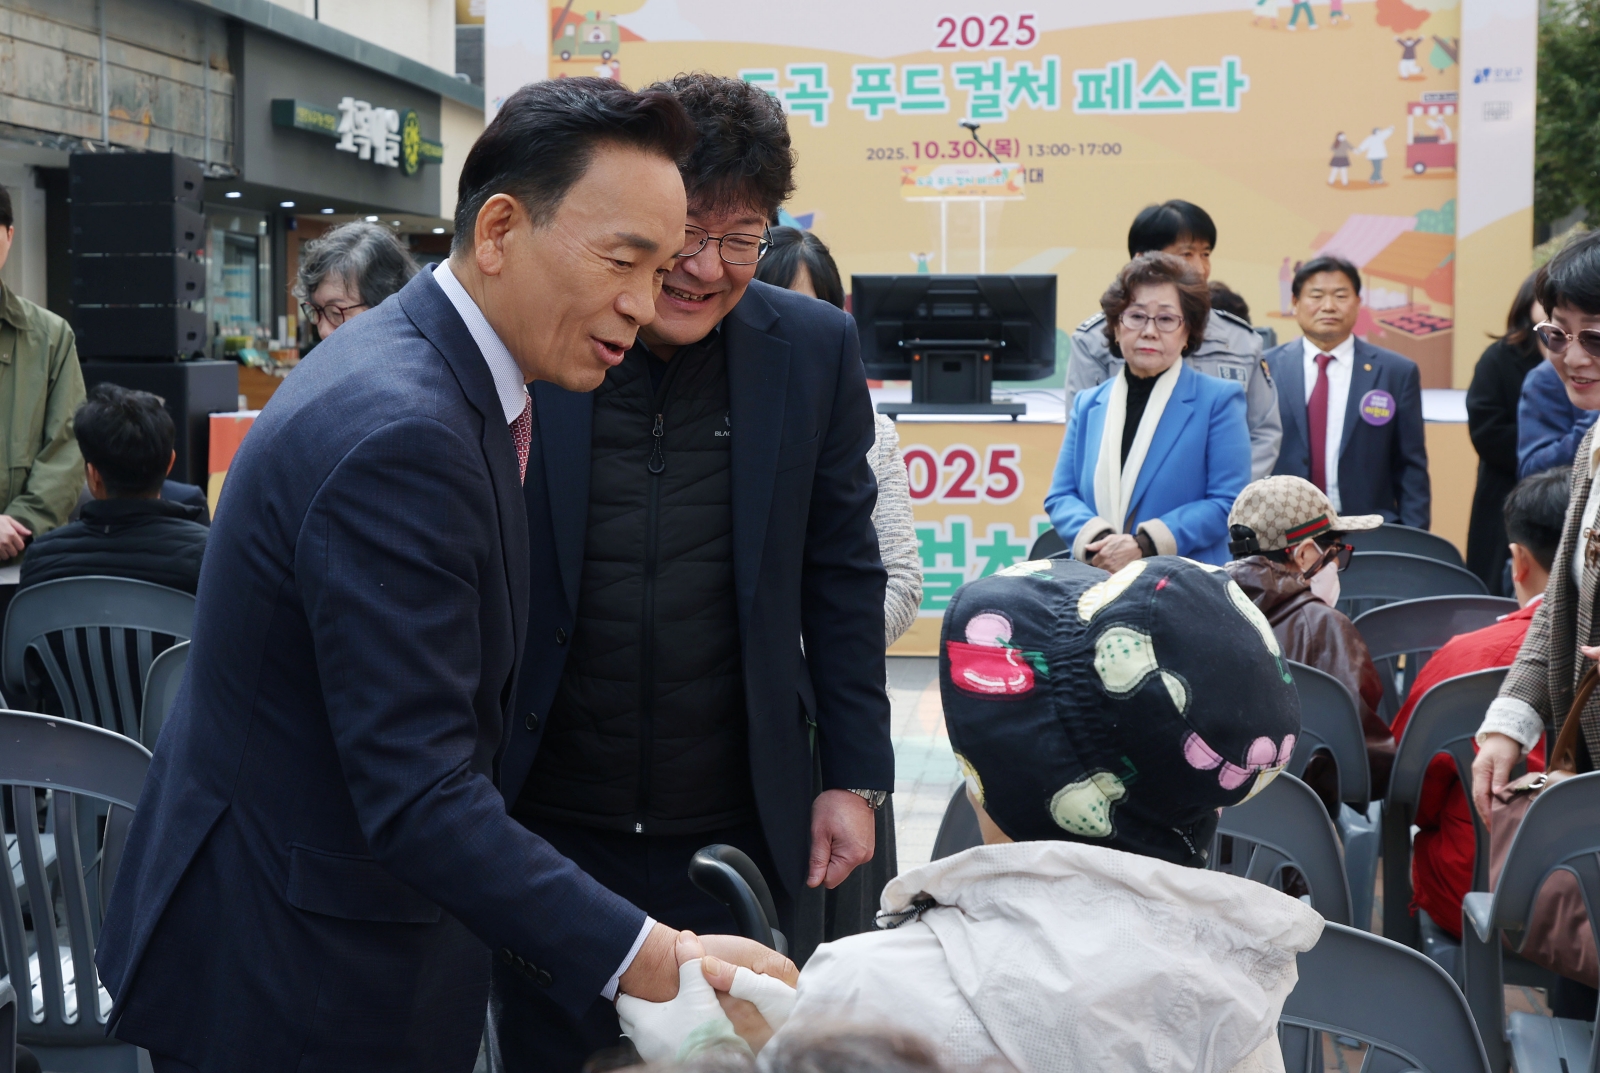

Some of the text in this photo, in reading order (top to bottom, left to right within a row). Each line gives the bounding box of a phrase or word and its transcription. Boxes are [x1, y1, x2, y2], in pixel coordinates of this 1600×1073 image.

[937, 15, 1036, 48] 2025
[1077, 60, 1245, 110] 페스타
[866, 147, 909, 161] 2025.
[1027, 142, 1122, 157] 13:00-17:00
[904, 449, 1018, 499] 025
